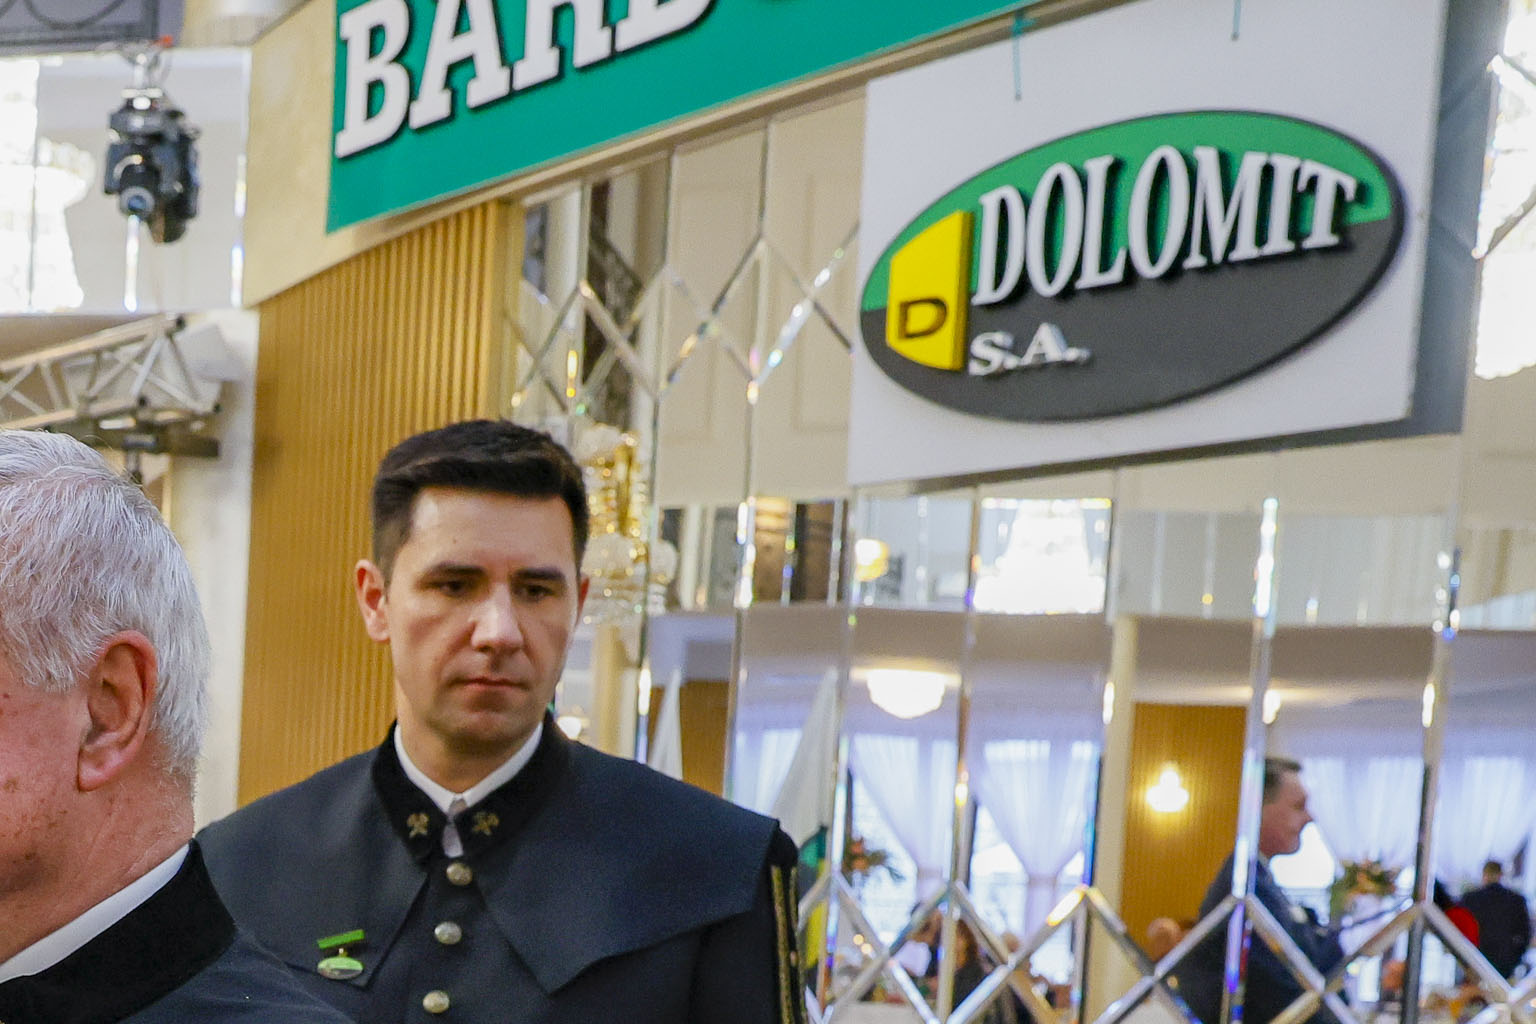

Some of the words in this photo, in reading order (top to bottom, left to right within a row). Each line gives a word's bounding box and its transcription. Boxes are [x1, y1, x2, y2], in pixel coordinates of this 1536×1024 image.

[971, 145, 1357, 306] DOLOMIT
[898, 297, 947, 340] D
[968, 322, 1090, 377] S.A.
